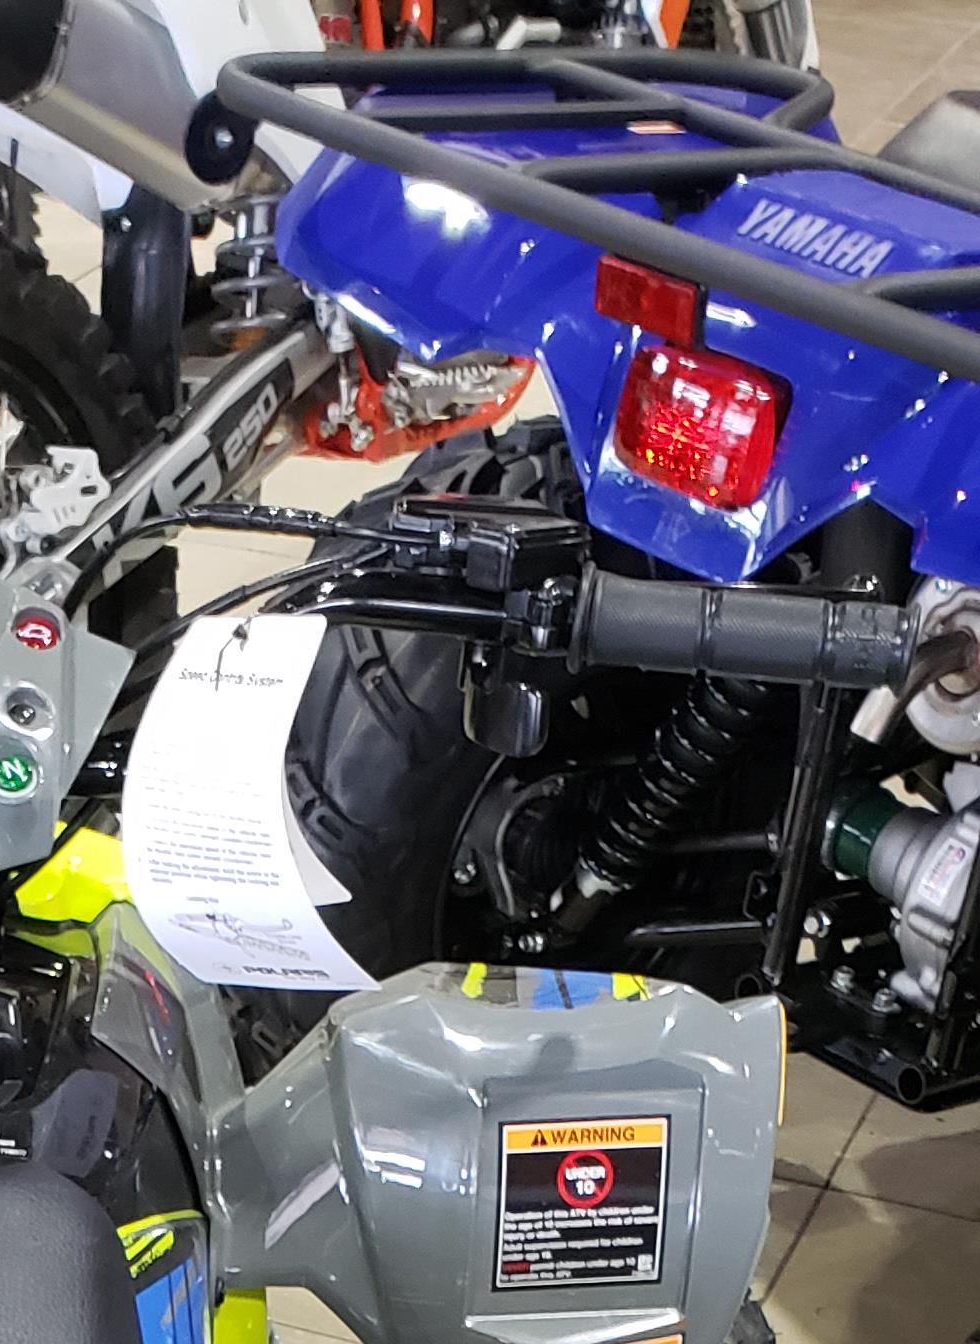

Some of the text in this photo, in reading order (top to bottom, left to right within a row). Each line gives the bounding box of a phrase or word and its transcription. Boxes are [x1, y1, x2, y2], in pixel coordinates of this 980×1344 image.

[737, 198, 894, 279] YAMAHA
[223, 382, 278, 473] 250
[3, 760, 27, 781] N
[242, 965, 330, 978] POLARIS
[551, 1126, 635, 1144] WARNING
[565, 1166, 606, 1181] UNDER
[575, 1181, 595, 1196] 10
[570, 1209, 586, 1218] ATV
